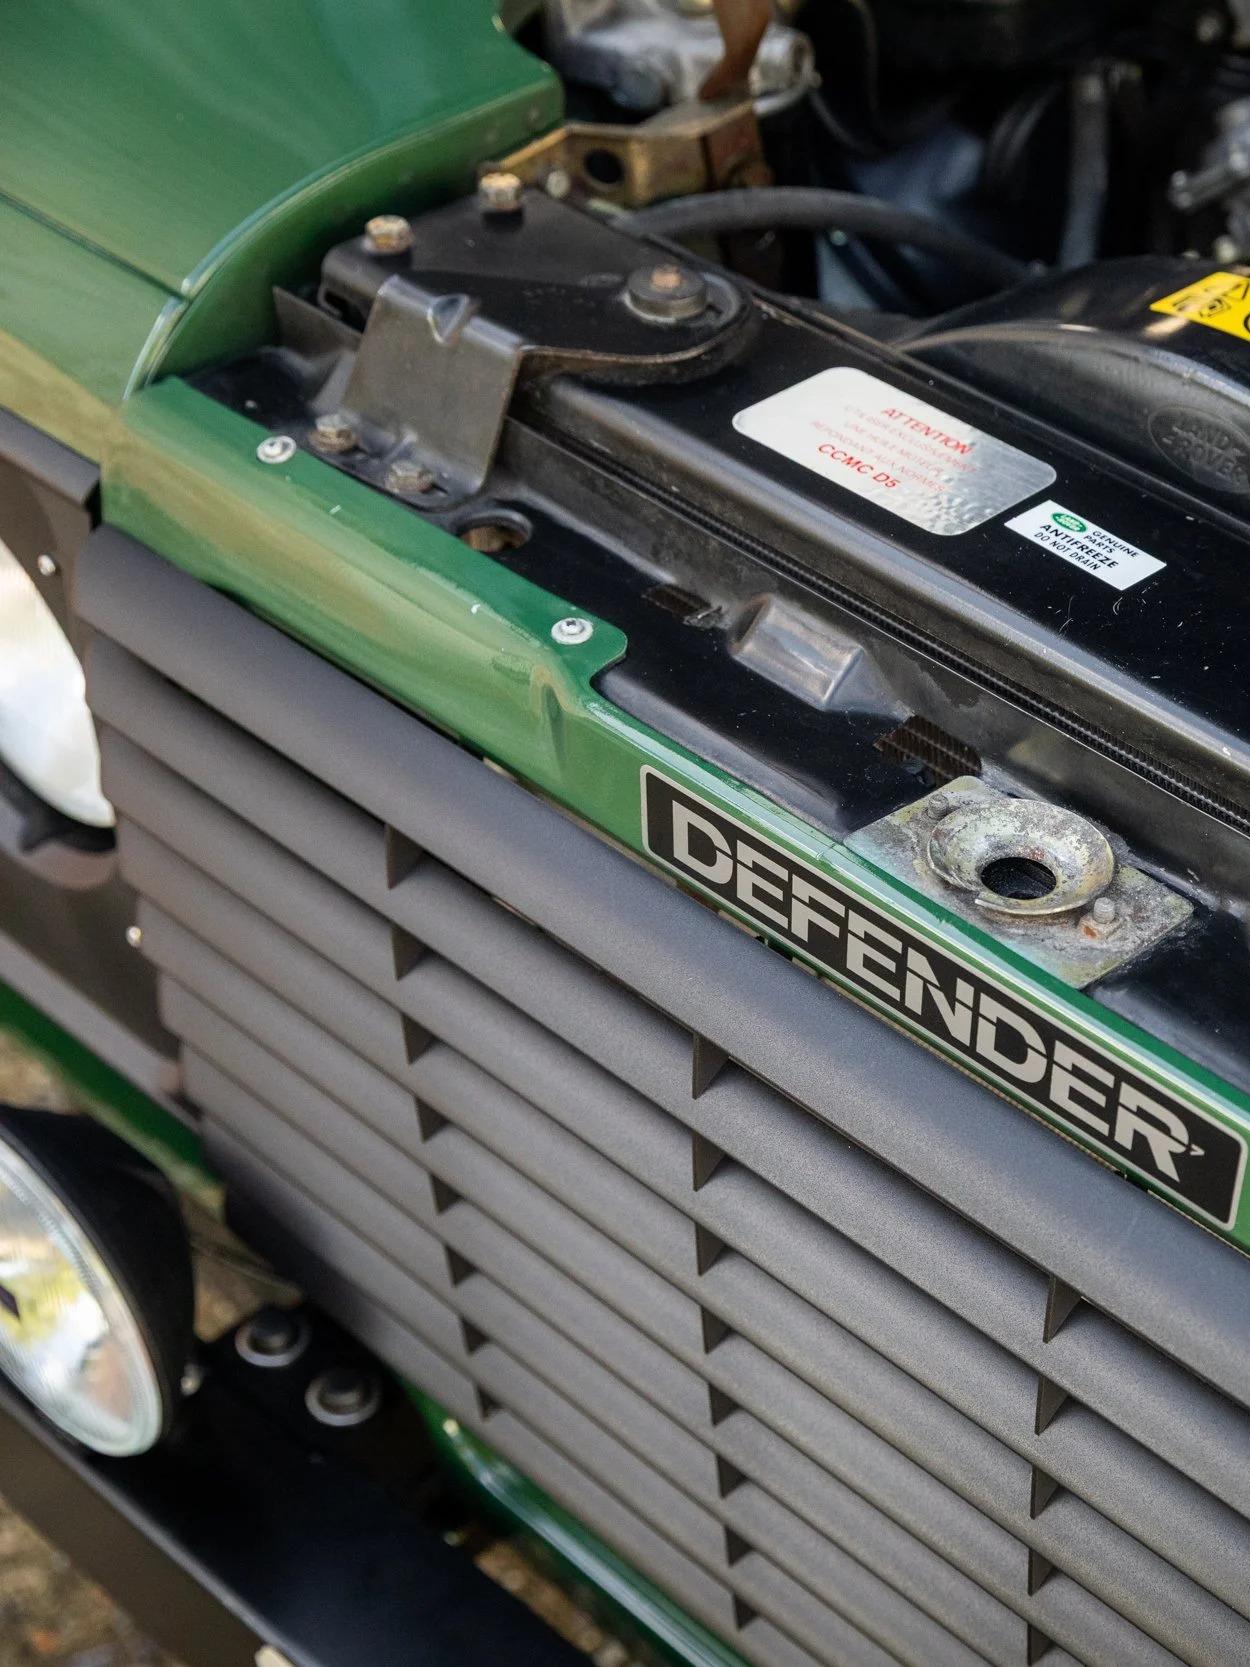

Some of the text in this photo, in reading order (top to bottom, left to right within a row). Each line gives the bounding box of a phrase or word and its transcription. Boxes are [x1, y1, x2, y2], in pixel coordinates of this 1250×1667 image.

[882, 408, 973, 454] ATTENTION
[818, 443, 901, 488] CCMC D5
[1034, 532, 1101, 571] DO NOT DRAIN
[1040, 524, 1119, 568] ANTIFREEZE
[1084, 535, 1116, 554] PARTS
[1092, 530, 1140, 558] GENUINE
[672, 800, 1190, 1182] DEFENDER
